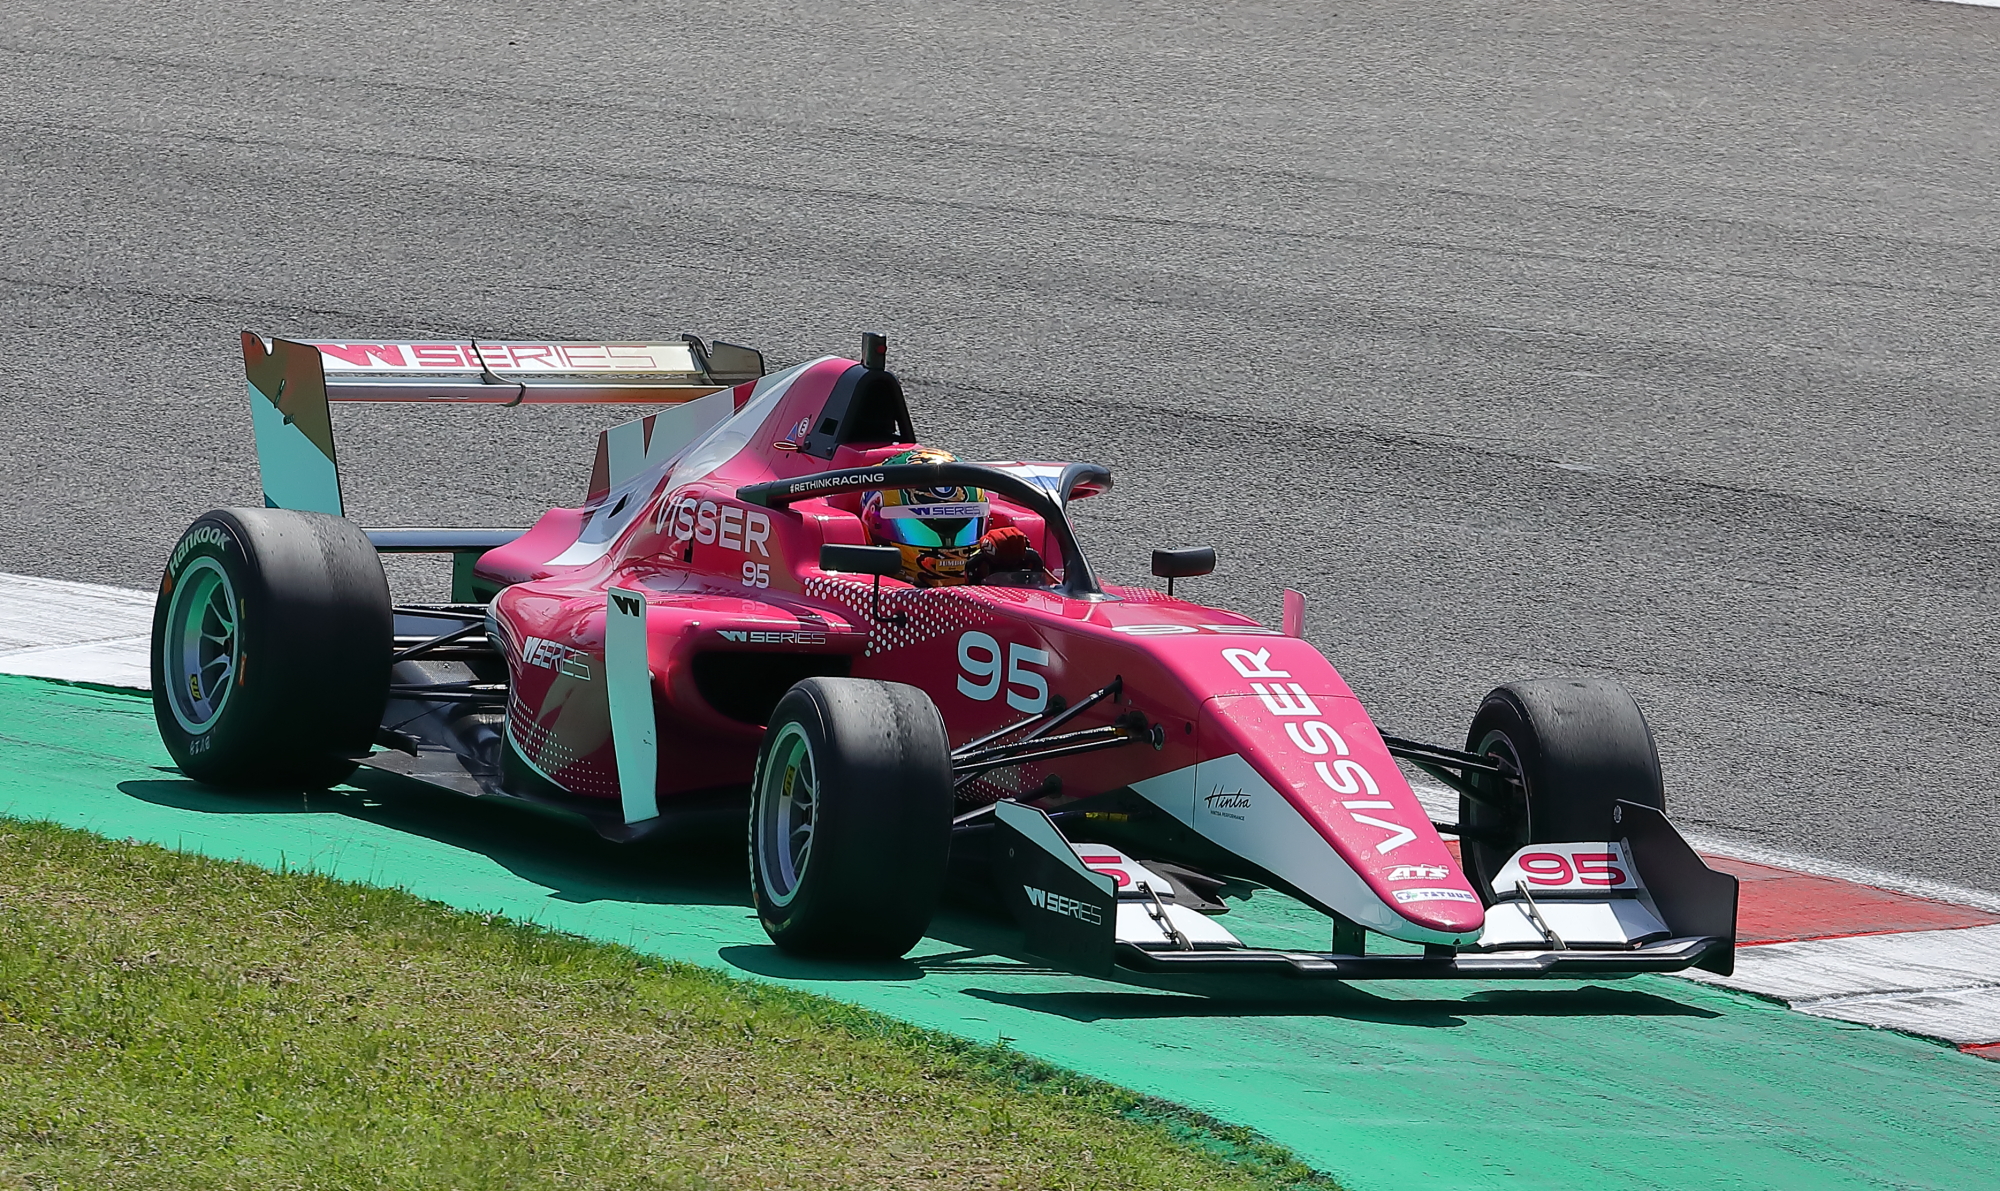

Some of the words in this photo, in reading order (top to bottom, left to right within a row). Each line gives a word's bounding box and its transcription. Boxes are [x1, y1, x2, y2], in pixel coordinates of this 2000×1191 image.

[410, 344, 657, 368] SERIES
[789, 473, 885, 494] #RETHINKRACING
[655, 495, 770, 558] VISSER
[742, 561, 770, 589] 95
[750, 631, 826, 645] SERIES
[957, 630, 1049, 714] 95
[1221, 647, 1418, 855] VISSER
[1204, 784, 1251, 808] Hintsa
[1080, 855, 1131, 887] 5
[1518, 852, 1627, 886] 95
[1047, 892, 1102, 925] SERIES
